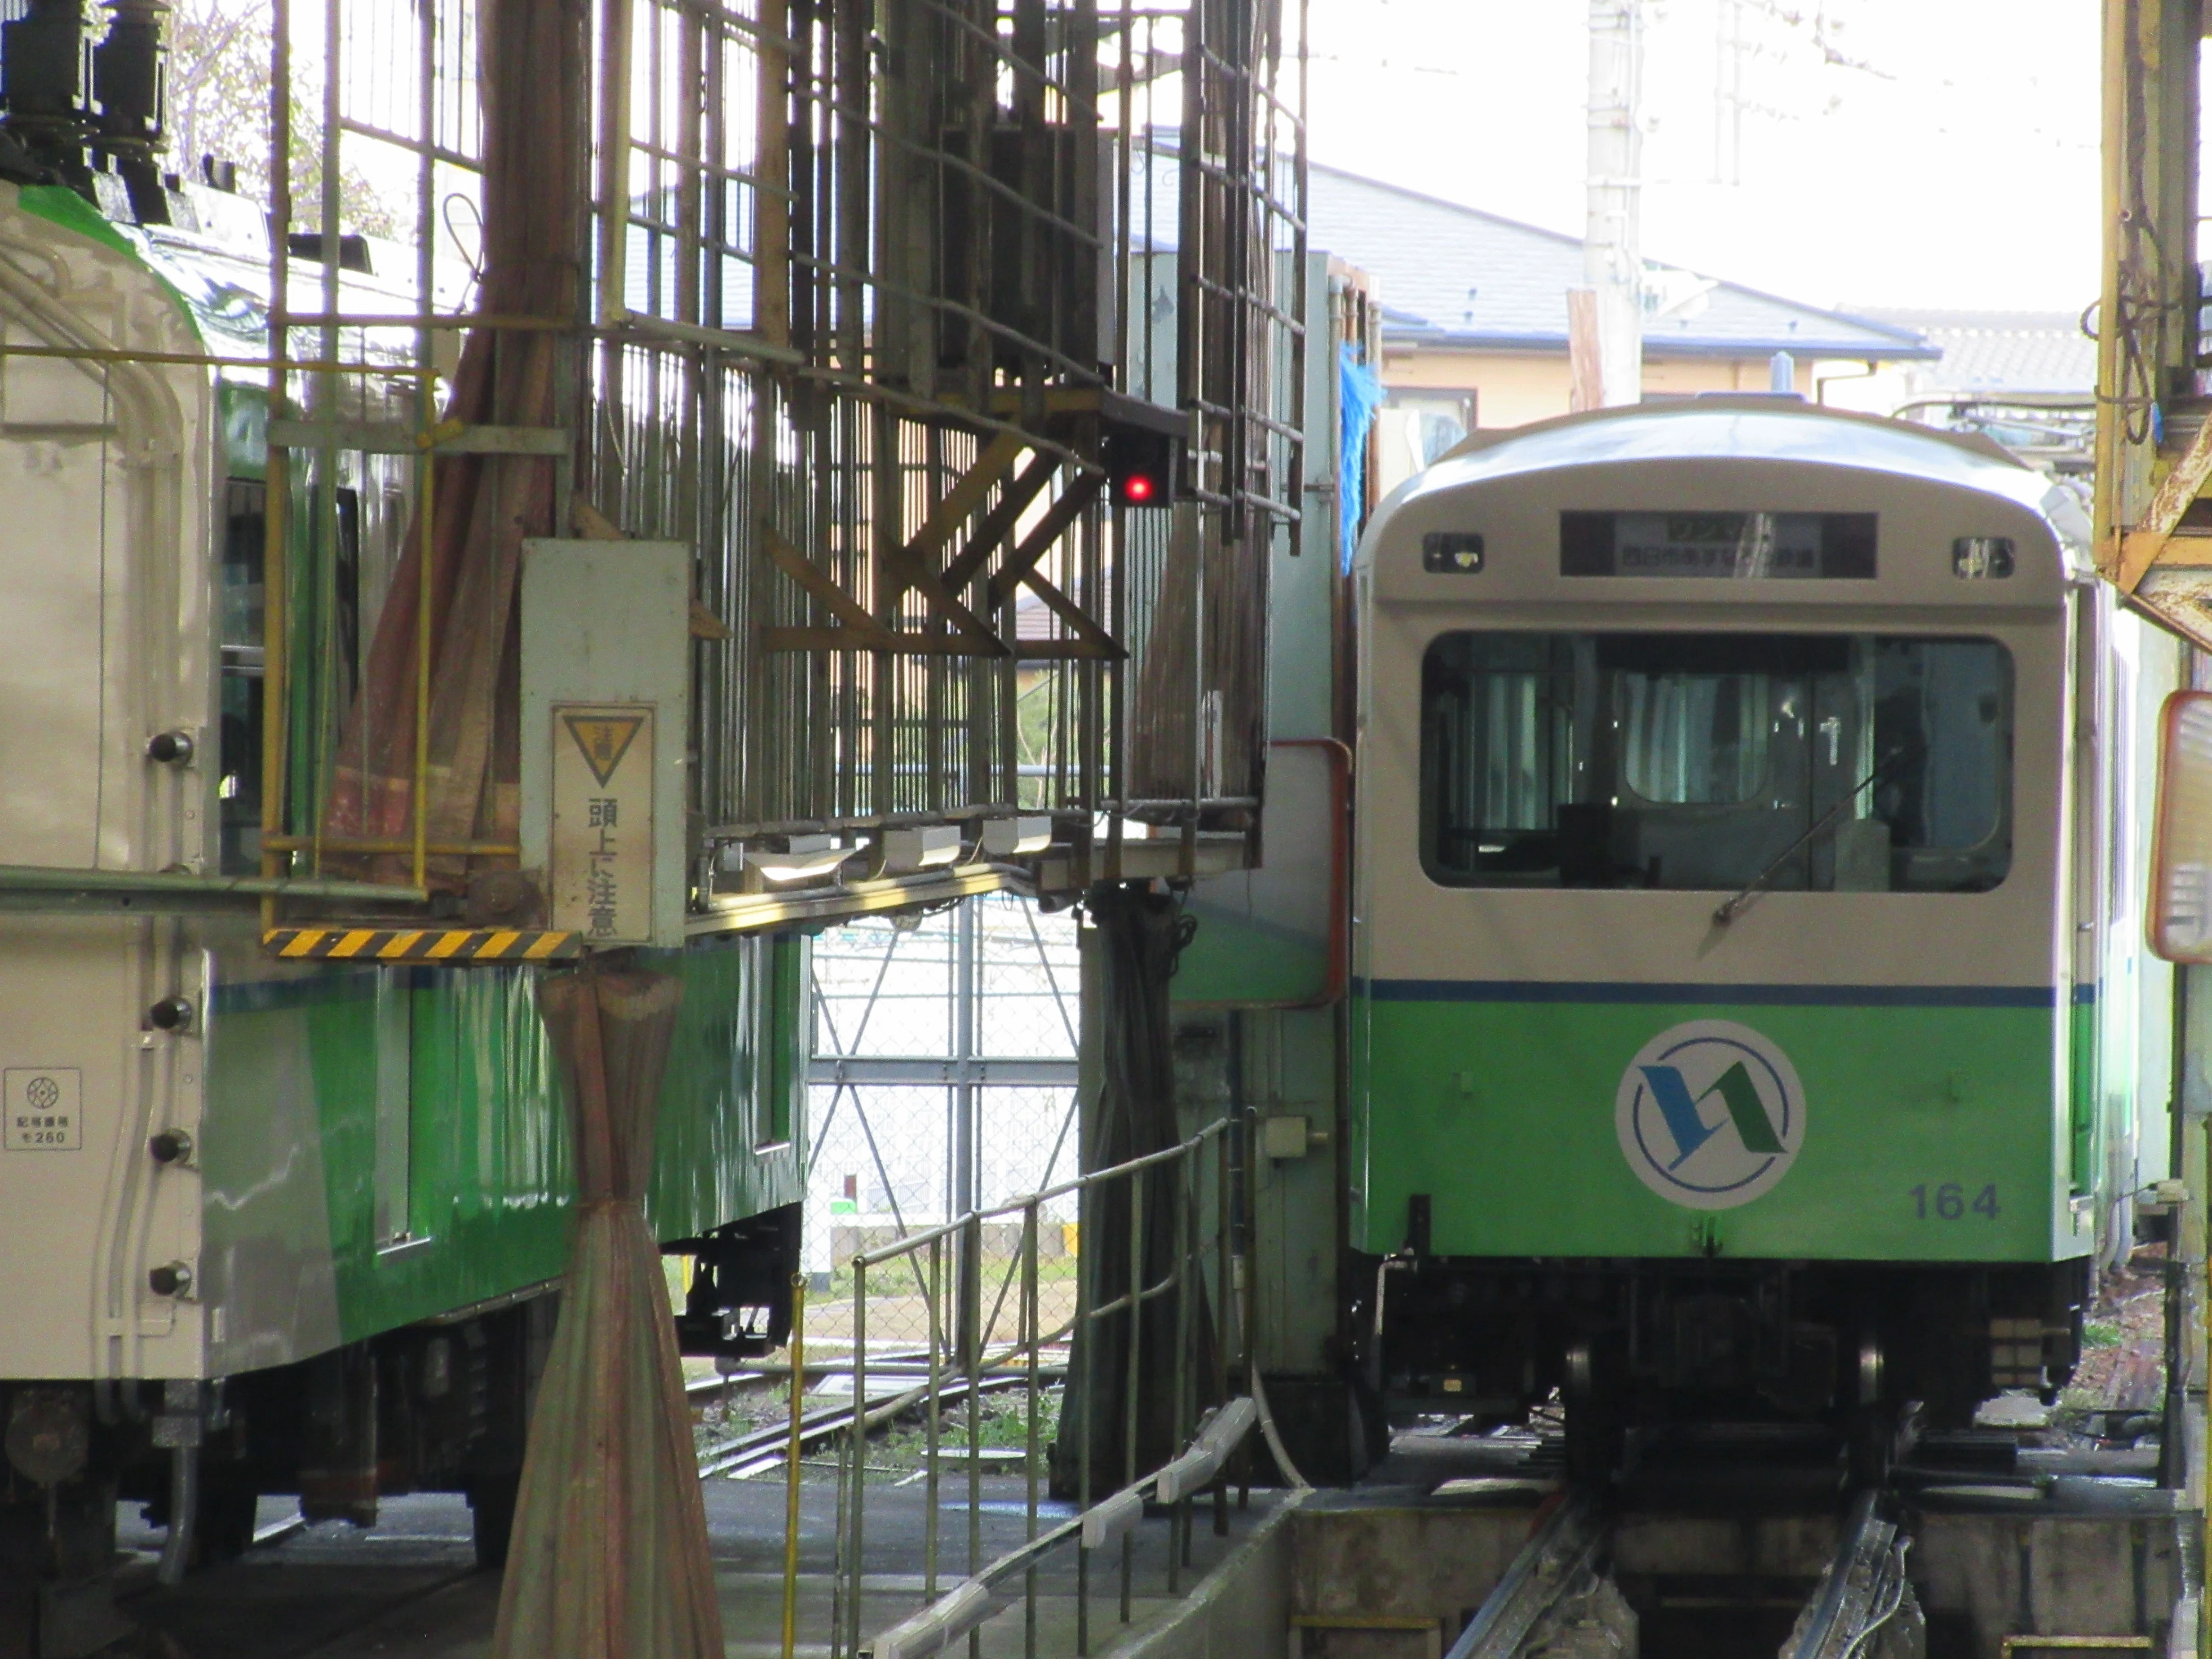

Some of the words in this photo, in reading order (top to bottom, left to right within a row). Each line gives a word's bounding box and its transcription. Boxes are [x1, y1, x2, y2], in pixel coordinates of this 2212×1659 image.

[594, 726, 613, 759] 注意
[588, 798, 617, 936] 頭上に注意
[1909, 1183, 2001, 1220] 164
